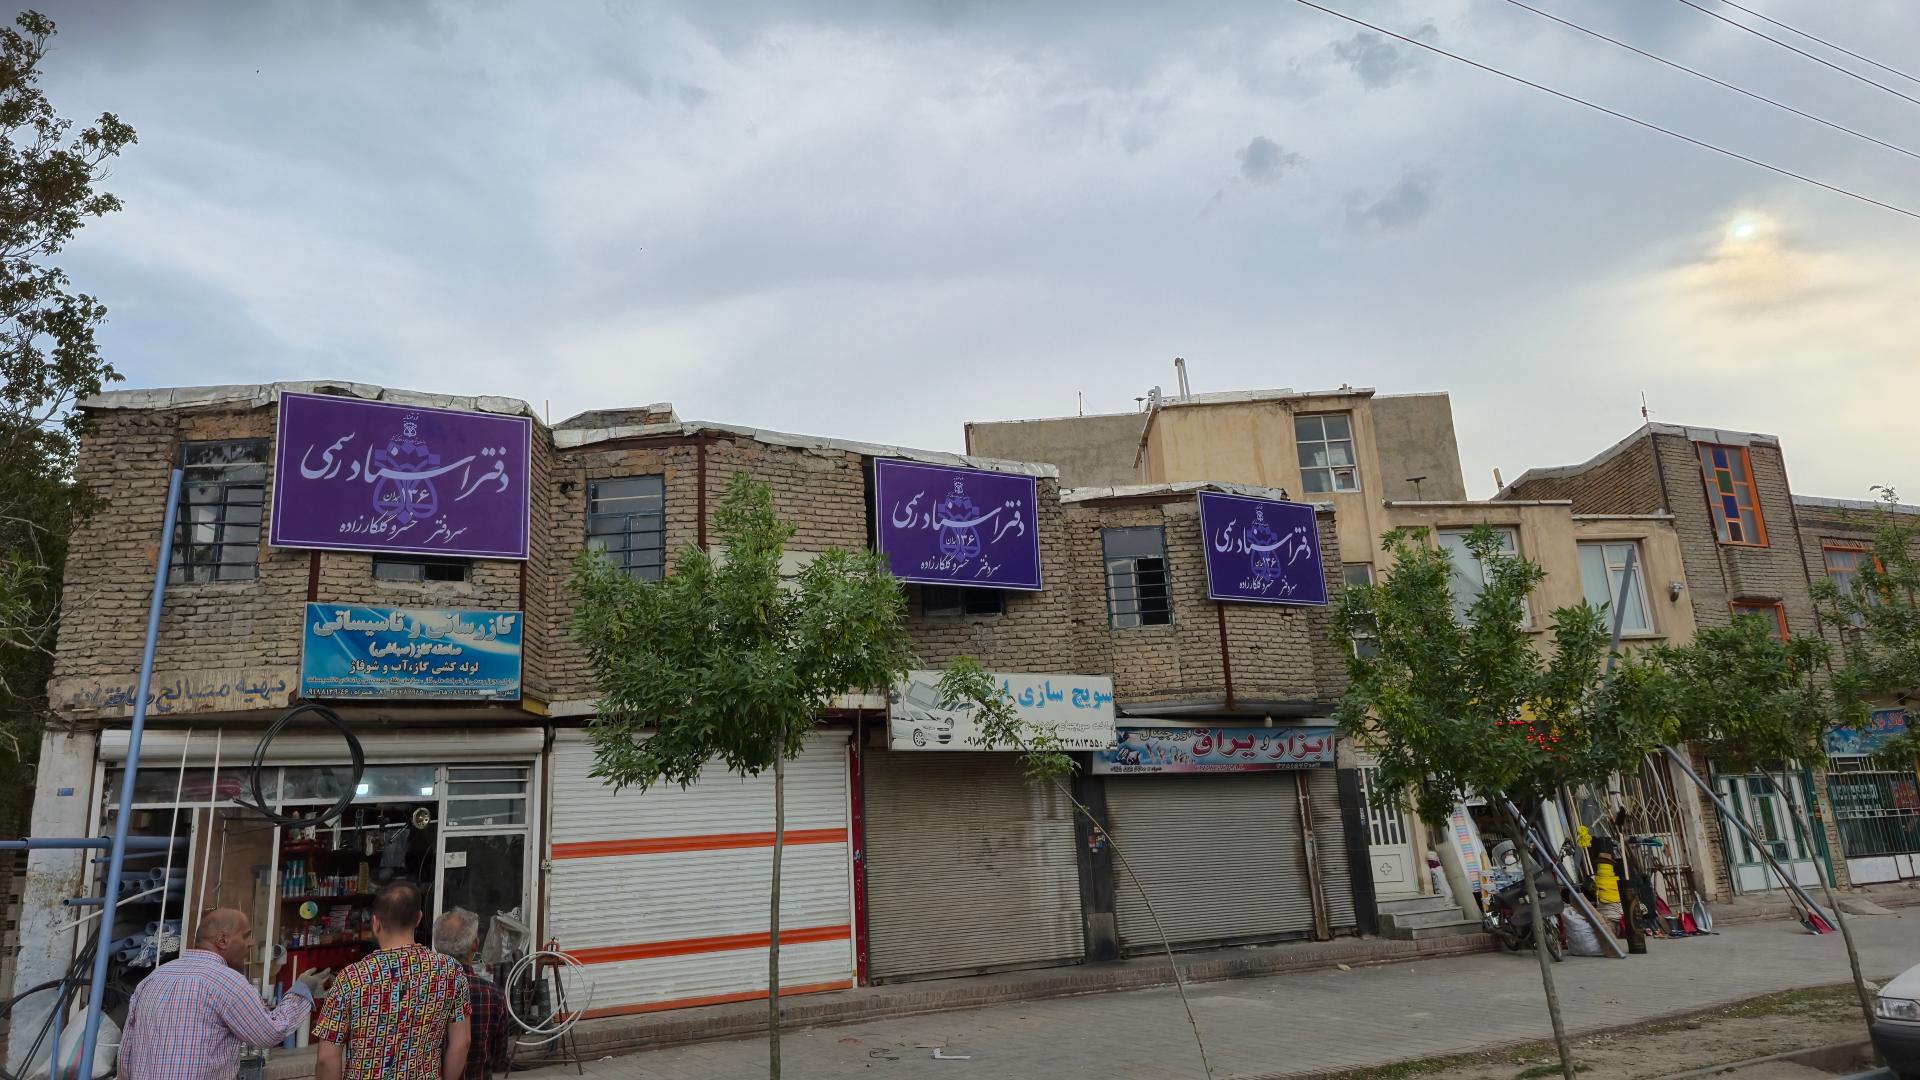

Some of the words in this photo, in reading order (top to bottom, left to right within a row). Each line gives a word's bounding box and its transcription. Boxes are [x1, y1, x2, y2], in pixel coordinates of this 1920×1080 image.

[299, 431, 356, 480] رسمی
[346, 443, 477, 491] اسناد
[454, 446, 510, 501] دفتر
[892, 490, 925, 529] رسمی
[921, 499, 1003, 535] اسناد
[990, 500, 1025, 544] دفتر
[1215, 518, 1237, 552] رسمی
[1236, 526, 1293, 558] اسناد
[1287, 526, 1312, 566] دفتر
[407, 619, 421, 639] و
[350, 659, 380, 674] شوفاژ
[382, 662, 389, 674] و
[391, 659, 408, 673] آب
[431, 660, 457, 674] کشی
[459, 660, 479, 675] لوله
[1018, 679, 1064, 709] سازی
[1191, 727, 1257, 759] یراق
[1259, 735, 1270, 751] و
[1268, 733, 1334, 760] ابزار
